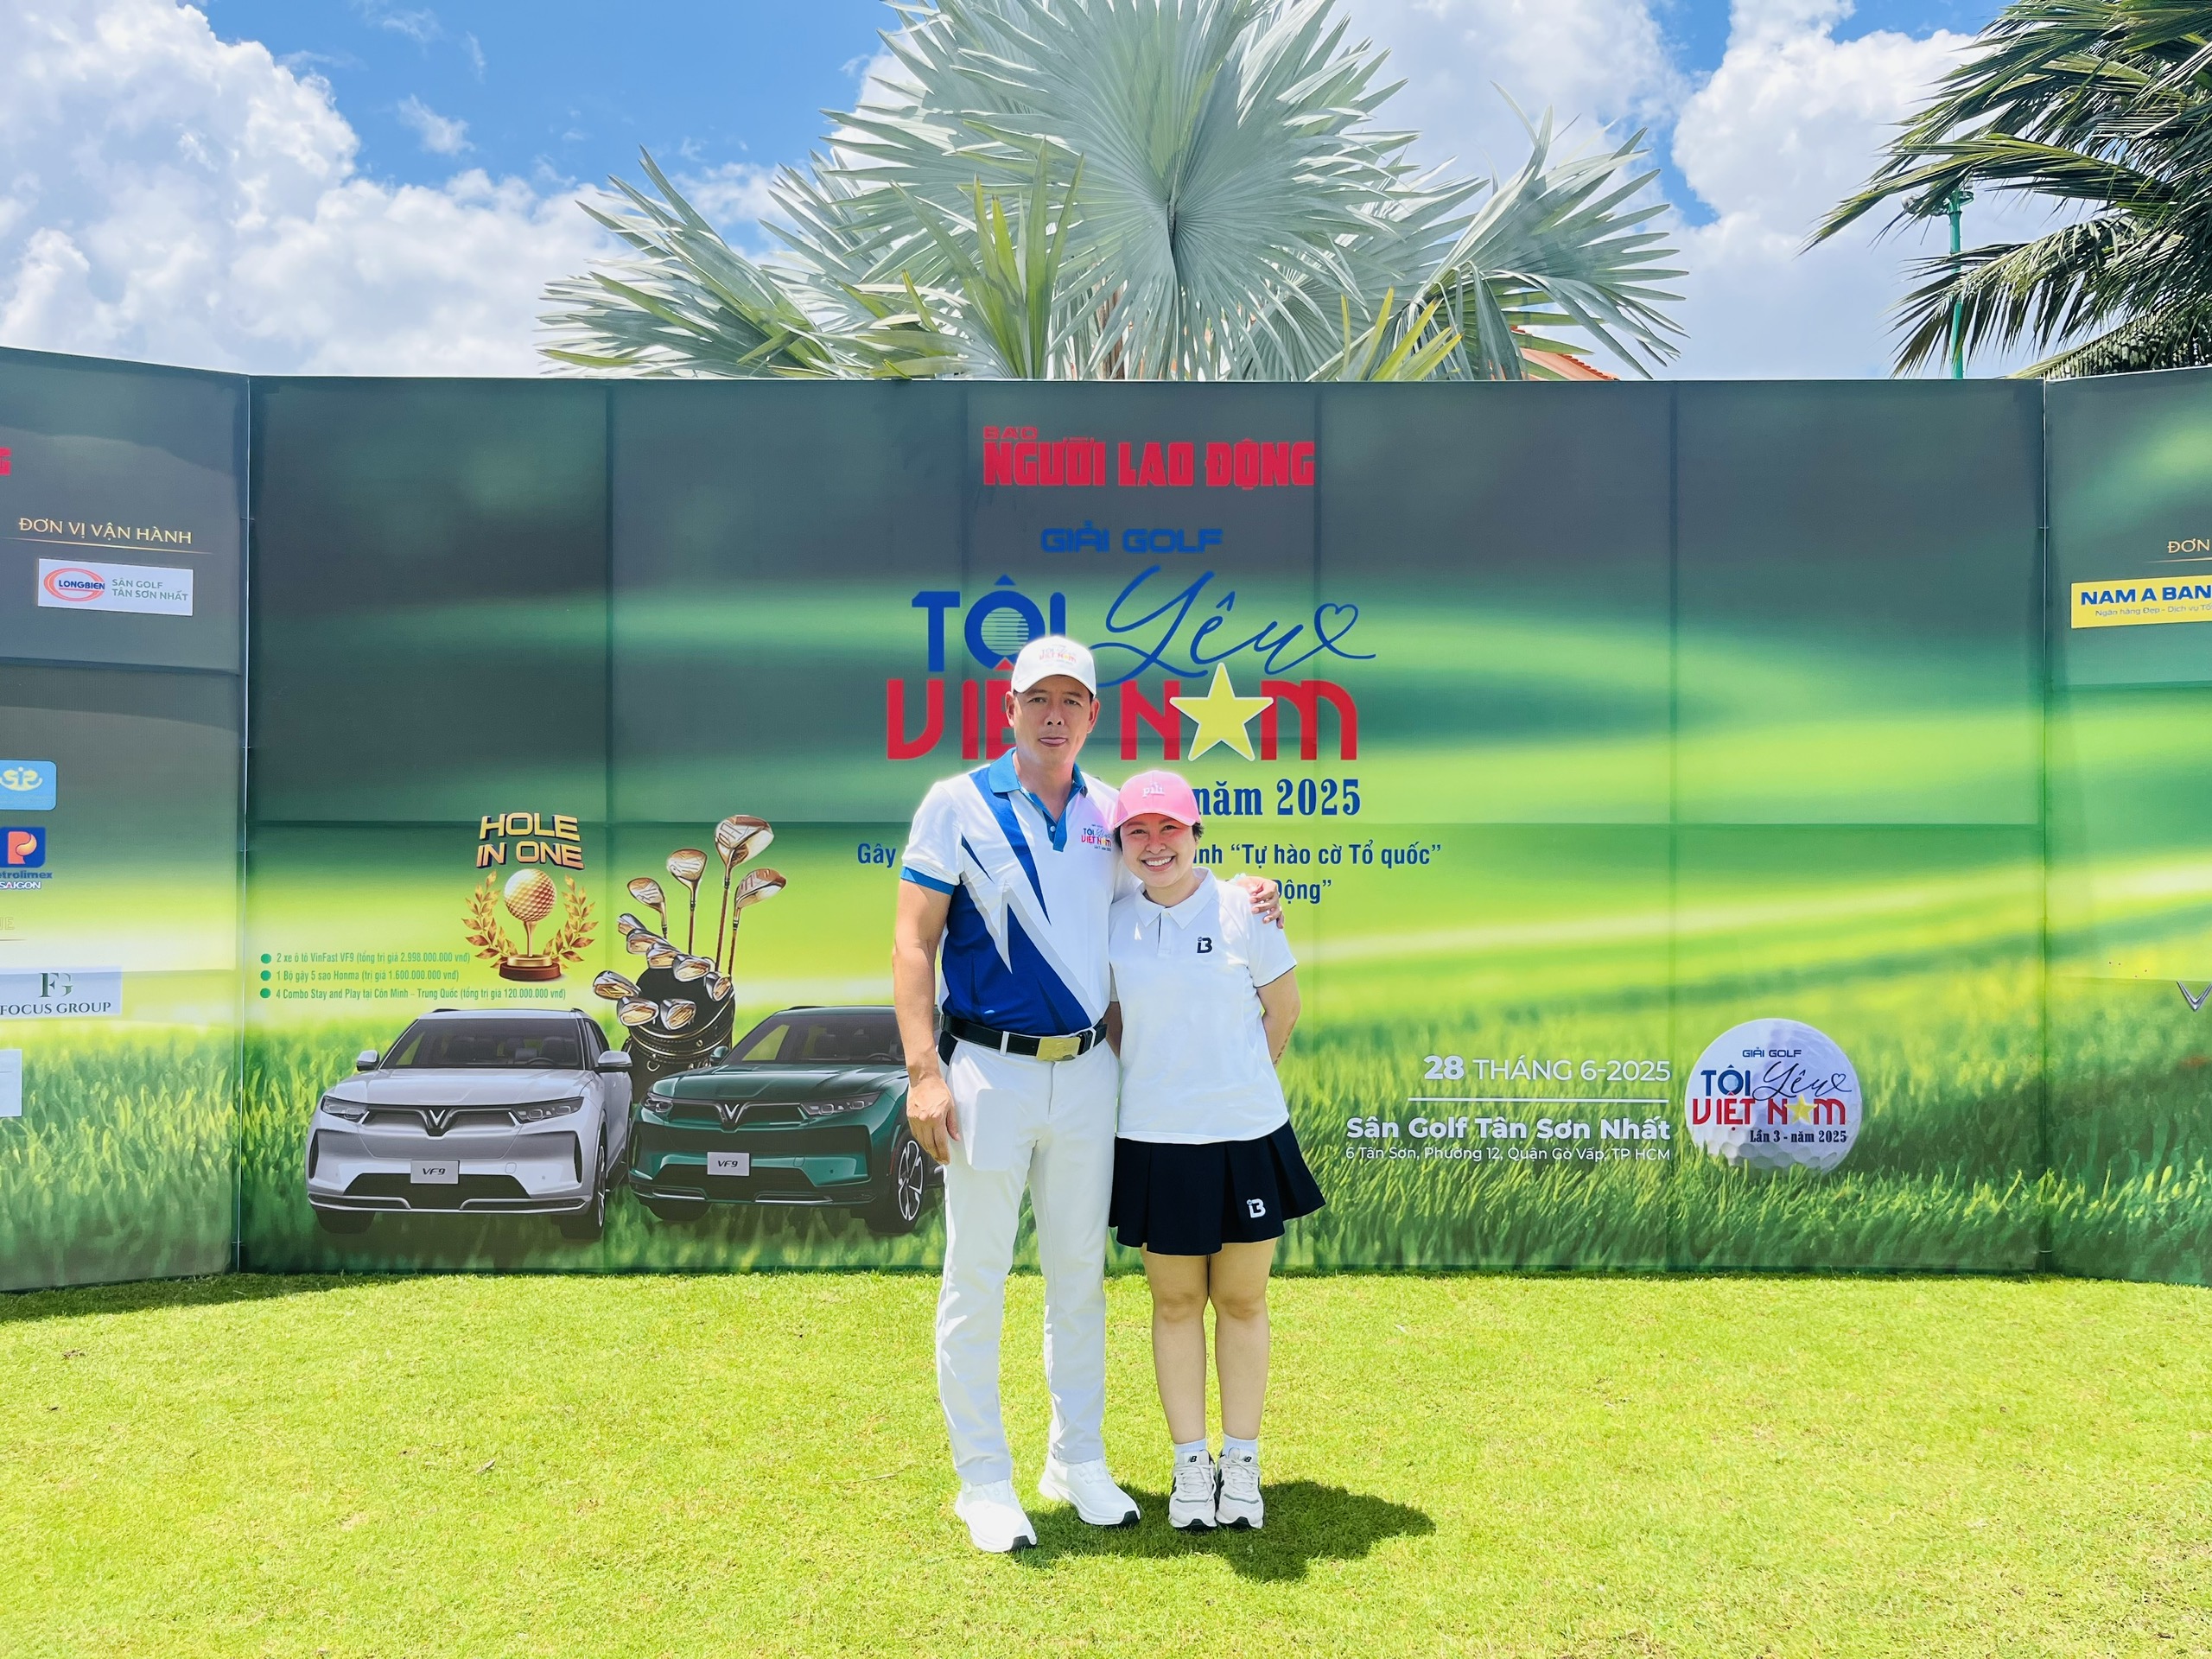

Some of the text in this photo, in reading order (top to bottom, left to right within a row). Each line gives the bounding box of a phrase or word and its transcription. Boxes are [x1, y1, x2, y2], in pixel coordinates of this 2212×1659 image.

[983, 437, 1315, 490] NGƯỜI LAO ĐỘNG
[18, 518, 193, 543] ĐƠN VỊ VẬN HÀNH
[1041, 520, 1224, 554] GIẢI GOLF
[2167, 538, 2210, 554] ĐƠN
[112, 577, 163, 589] SÂN GOLF
[112, 588, 188, 601] TÂN SƠN NHẤT
[2081, 588, 2136, 606] NAM
[2140, 588, 2158, 602] A
[912, 574, 1067, 672] TÔI
[1276, 779, 1361, 817] 2025
[480, 811, 581, 842] HOLE
[476, 840, 585, 870] IN ONE
[857, 842, 897, 868] Gây
[1274, 843, 1311, 864] hào
[1319, 844, 1342, 864] cờ
[1349, 840, 1374, 864] Tổ
[0, 870, 53, 879] trolimex
[276, 952, 282, 963] 2
[283, 954, 292, 963] xe
[310, 952, 338, 963] VinFast
[340, 952, 354, 963] VF9
[387, 952, 398, 964] giá
[400, 952, 453, 963] 2.998.000.000
[276, 970, 281, 981] 1
[311, 970, 315, 981] 5
[318, 971, 331, 981] sao
[334, 970, 359, 980] Honma
[375, 970, 386, 982] giá
[389, 970, 442, 980] 1.600.000.000
[276, 989, 281, 999] 4
[283, 989, 308, 999] Combo
[310, 988, 327, 1001] Stay
[329, 988, 342, 999] and
[345, 988, 361, 1001] Play
[374, 988, 388, 998] Côn
[391, 988, 408, 998] Minh
[417, 988, 438, 1000] Trung
[440, 987, 458, 999] Quốc
[491, 988, 502, 1001] giá
[505, 988, 548, 999] 120.000.000
[0, 1002, 111, 1015] FOCUS GROUP
[1742, 1046, 1802, 1058] GIẢI GOLF
[1424, 1055, 1671, 1081] 28 THÁNG 6-2025
[1700, 1065, 1751, 1096] TÔI
[1692, 1091, 1756, 1131] VIỆT
[1346, 1116, 1671, 1140] Sân Golf Tân Sơn Nhất
[1750, 1128, 1770, 1143] Lần
[1773, 1129, 1781, 1143] 3
[1790, 1129, 1815, 1143] năm
[1818, 1129, 1847, 1143] 2025
[1345, 1146, 1670, 1162] 6 Tân Sơn, Phường 12, Quận Gò Vấp, TP HCM
[423, 1167, 446, 1176] VF9
[718, 1160, 739, 1168] VF9
